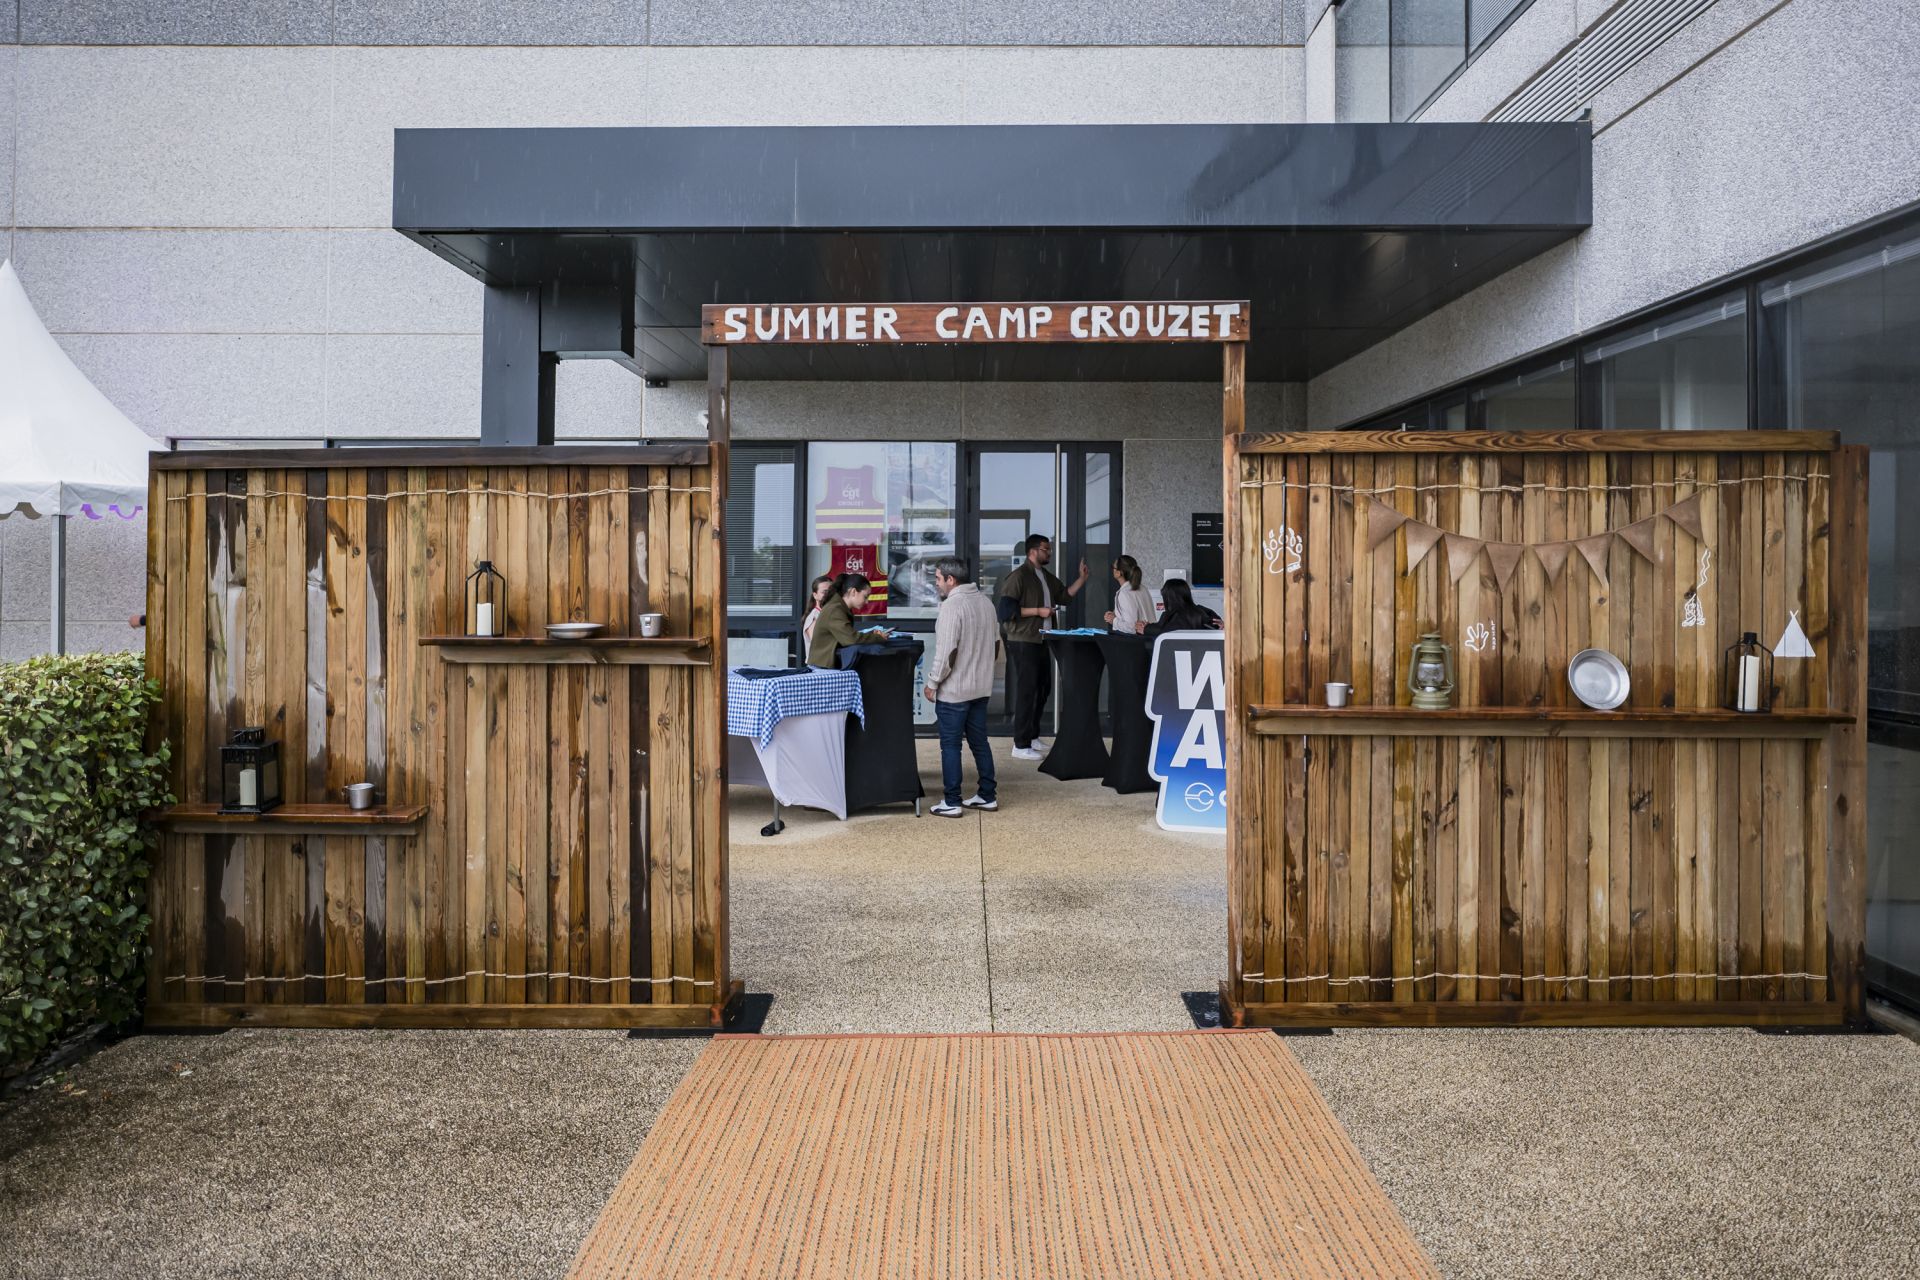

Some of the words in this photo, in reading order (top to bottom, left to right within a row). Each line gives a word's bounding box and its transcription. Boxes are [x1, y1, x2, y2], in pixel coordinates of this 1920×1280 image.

[724, 306, 900, 341] SUMMER
[935, 306, 1053, 340] CAMP
[1070, 303, 1241, 339] CROUZET
[842, 487, 861, 500] cgt
[846, 558, 864, 571] cgt
[1169, 708, 1227, 769] A
